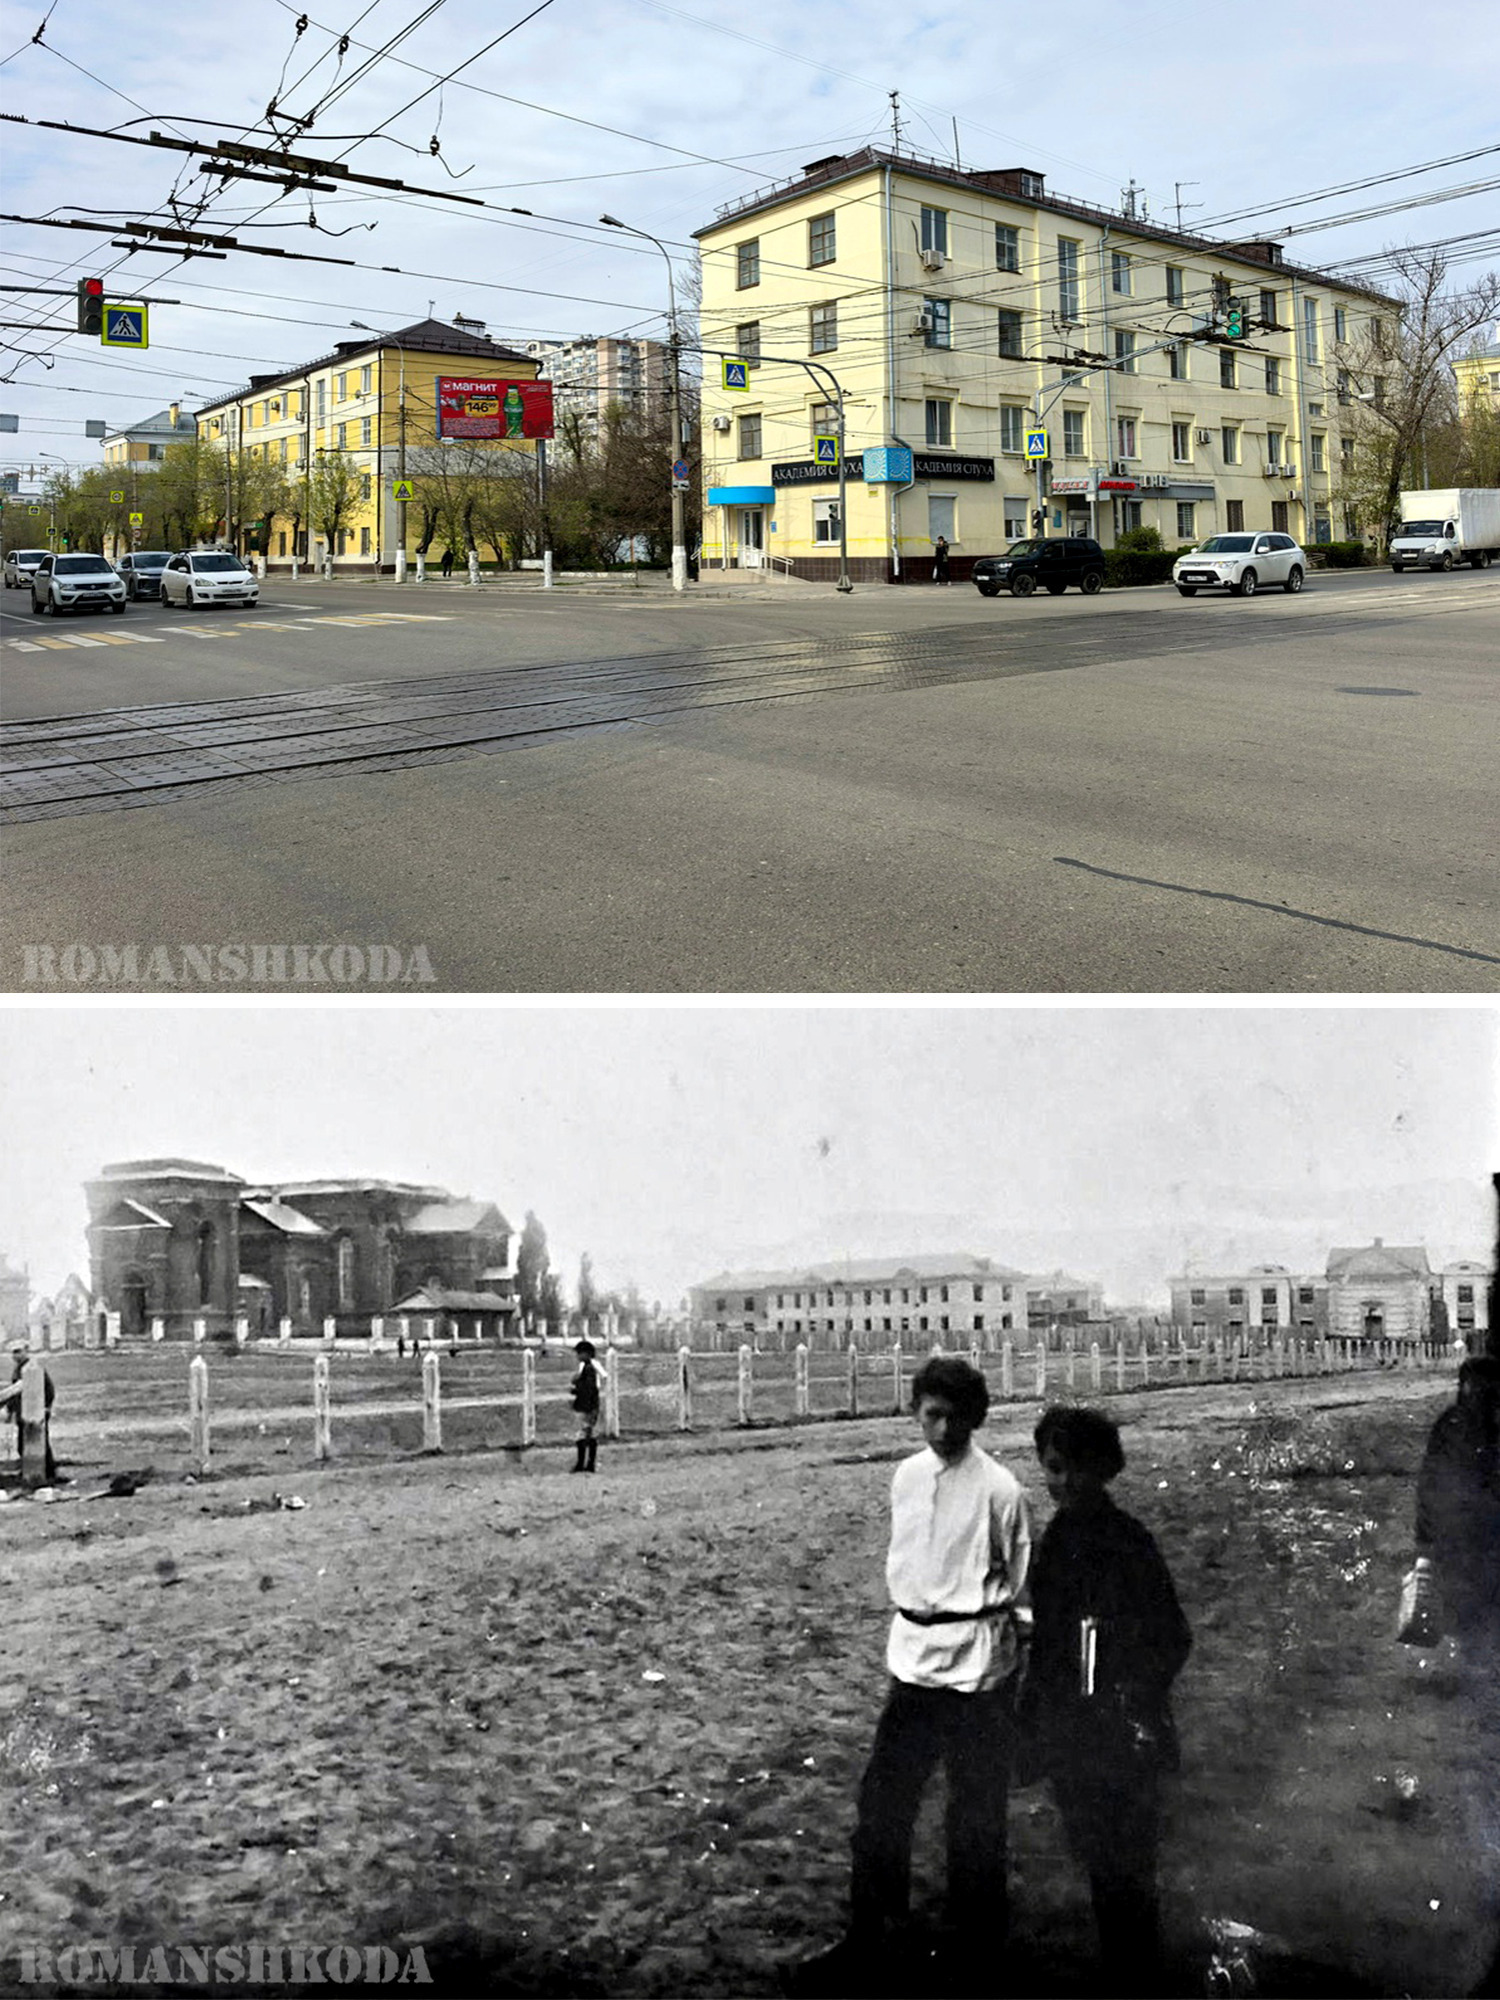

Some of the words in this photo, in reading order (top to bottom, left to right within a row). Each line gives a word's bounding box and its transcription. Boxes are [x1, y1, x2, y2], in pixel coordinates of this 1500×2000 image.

[467, 402, 489, 412] 146
[773, 465, 827, 480] АКАДЕМИЯ
[913, 460, 962, 474] КАДЕМИЯ
[963, 463, 994, 476] СЛУХА
